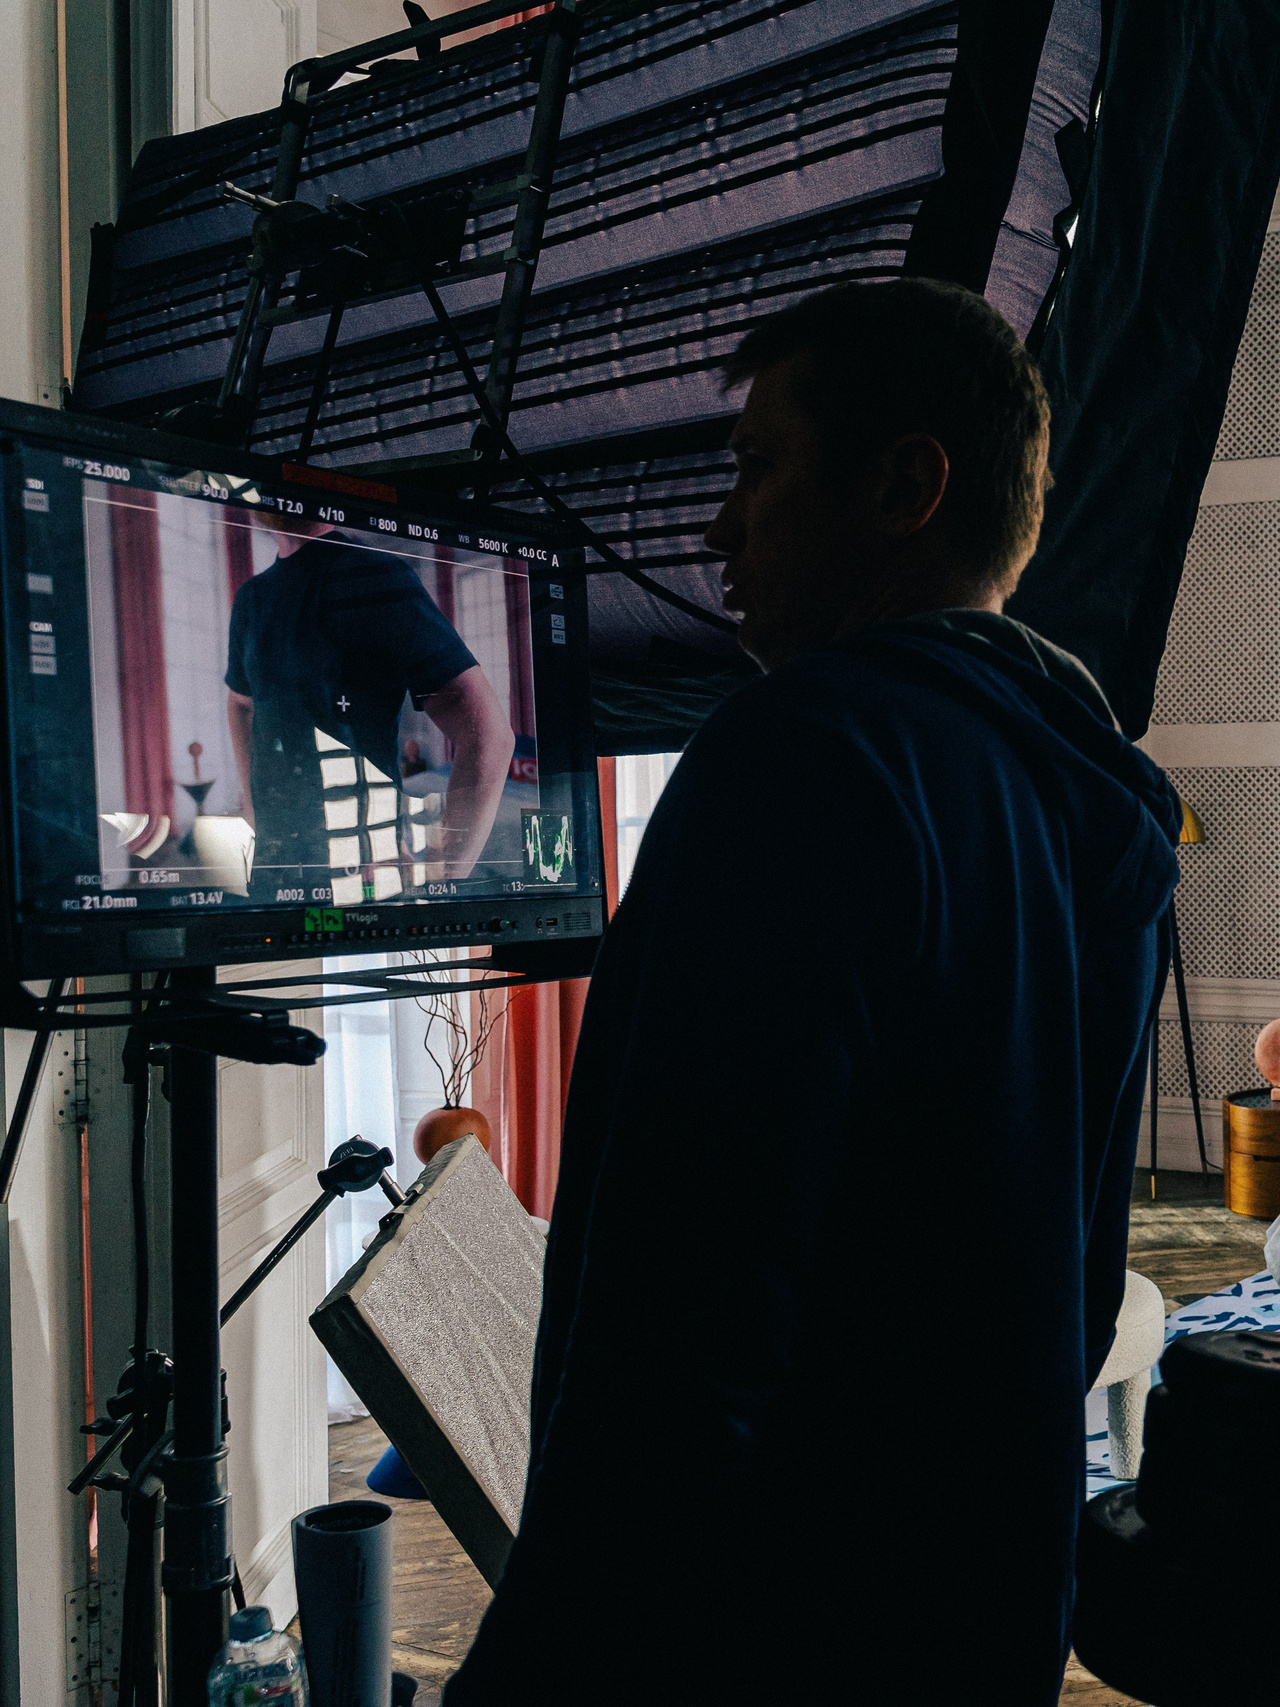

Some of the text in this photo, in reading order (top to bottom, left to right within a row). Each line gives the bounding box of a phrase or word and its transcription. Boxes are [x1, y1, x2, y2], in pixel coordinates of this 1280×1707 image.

[83, 460, 130, 481] 25.000
[26, 478, 44, 490] SDI
[202, 483, 229, 500] 90.0
[277, 498, 285, 511] T
[286, 501, 304, 515] 2.0
[318, 506, 345, 522] 4/10
[378, 518, 397, 532] 800
[408, 524, 422, 537] ND
[424, 527, 439, 540] 0.6
[458, 534, 547, 561] WB 5600 K +0.0 CC
[551, 554, 560, 568] A
[29, 621, 53, 633] CAM
[138, 871, 180, 885] 0.65m
[276, 888, 305, 901] A002
[429, 883, 448, 895] 0:24
[451, 882, 457, 894] h
[502, 883, 510, 892] TC
[81, 895, 138, 910] 21.0mm
[189, 891, 224, 906] 13.4V
